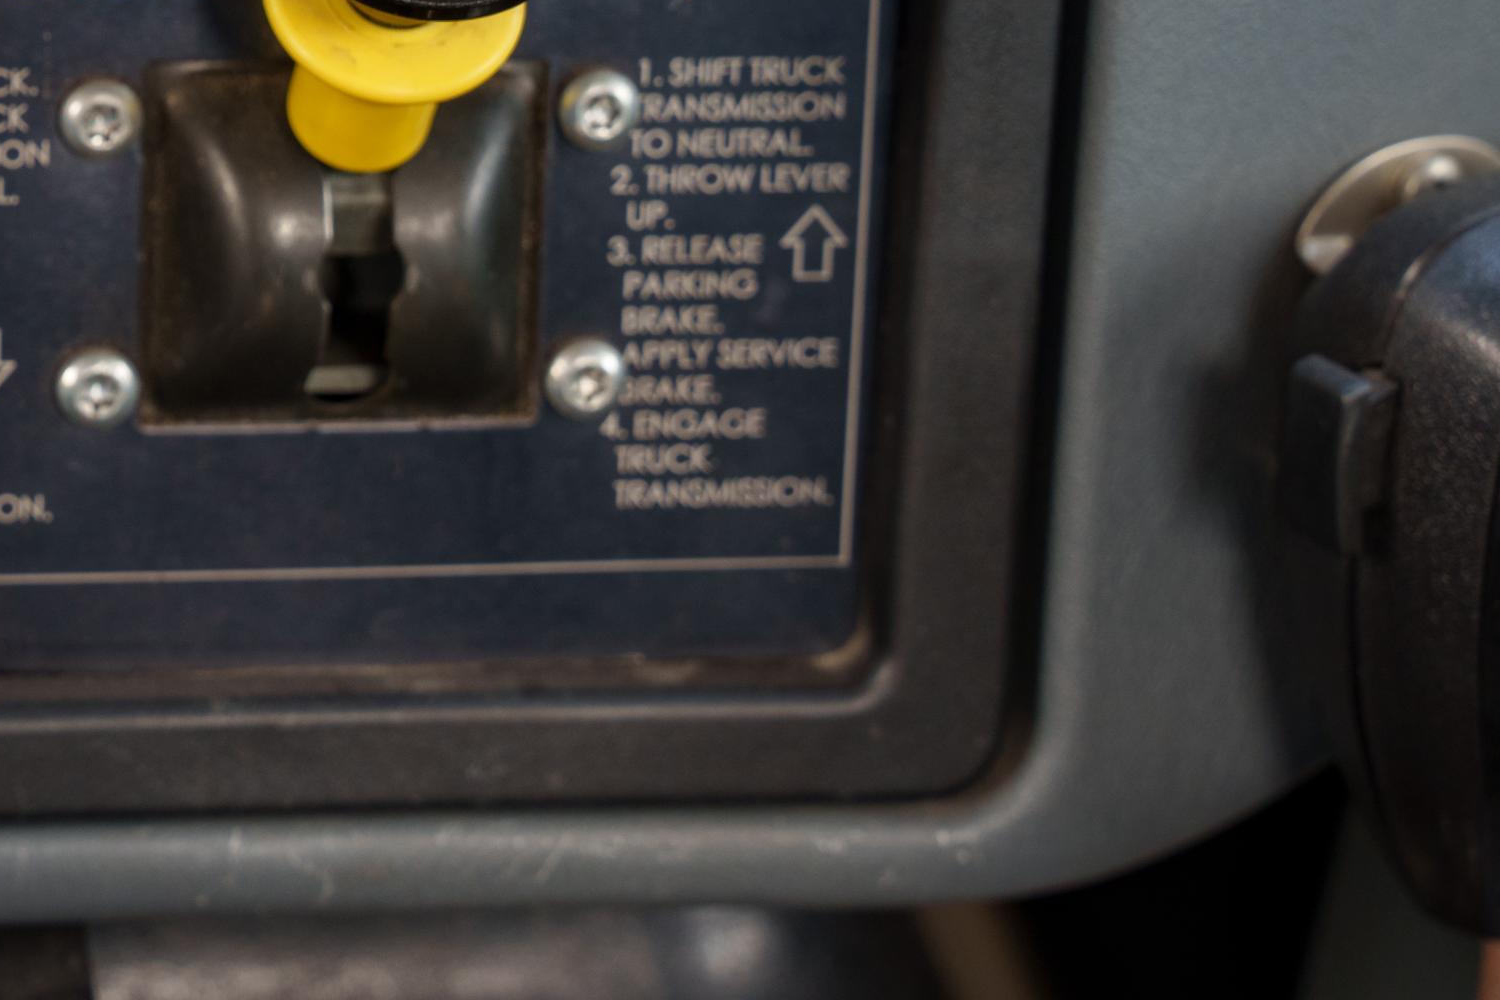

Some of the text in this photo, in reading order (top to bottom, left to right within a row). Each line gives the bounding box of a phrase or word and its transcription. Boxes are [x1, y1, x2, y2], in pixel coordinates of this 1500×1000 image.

[639, 55, 847, 88] 1. SHIFT TRUCK
[630, 127, 814, 160] TO NEUTRAL.
[609, 162, 850, 196] 2. THROW LEVER
[625, 200, 675, 231] UP.
[606, 234, 764, 267] 3. RELEASE
[622, 269, 759, 301] PARKING
[620, 303, 725, 336] BRAKE.
[622, 336, 839, 369] APPLY SERVICE
[600, 407, 767, 440] 4. ENGAGE
